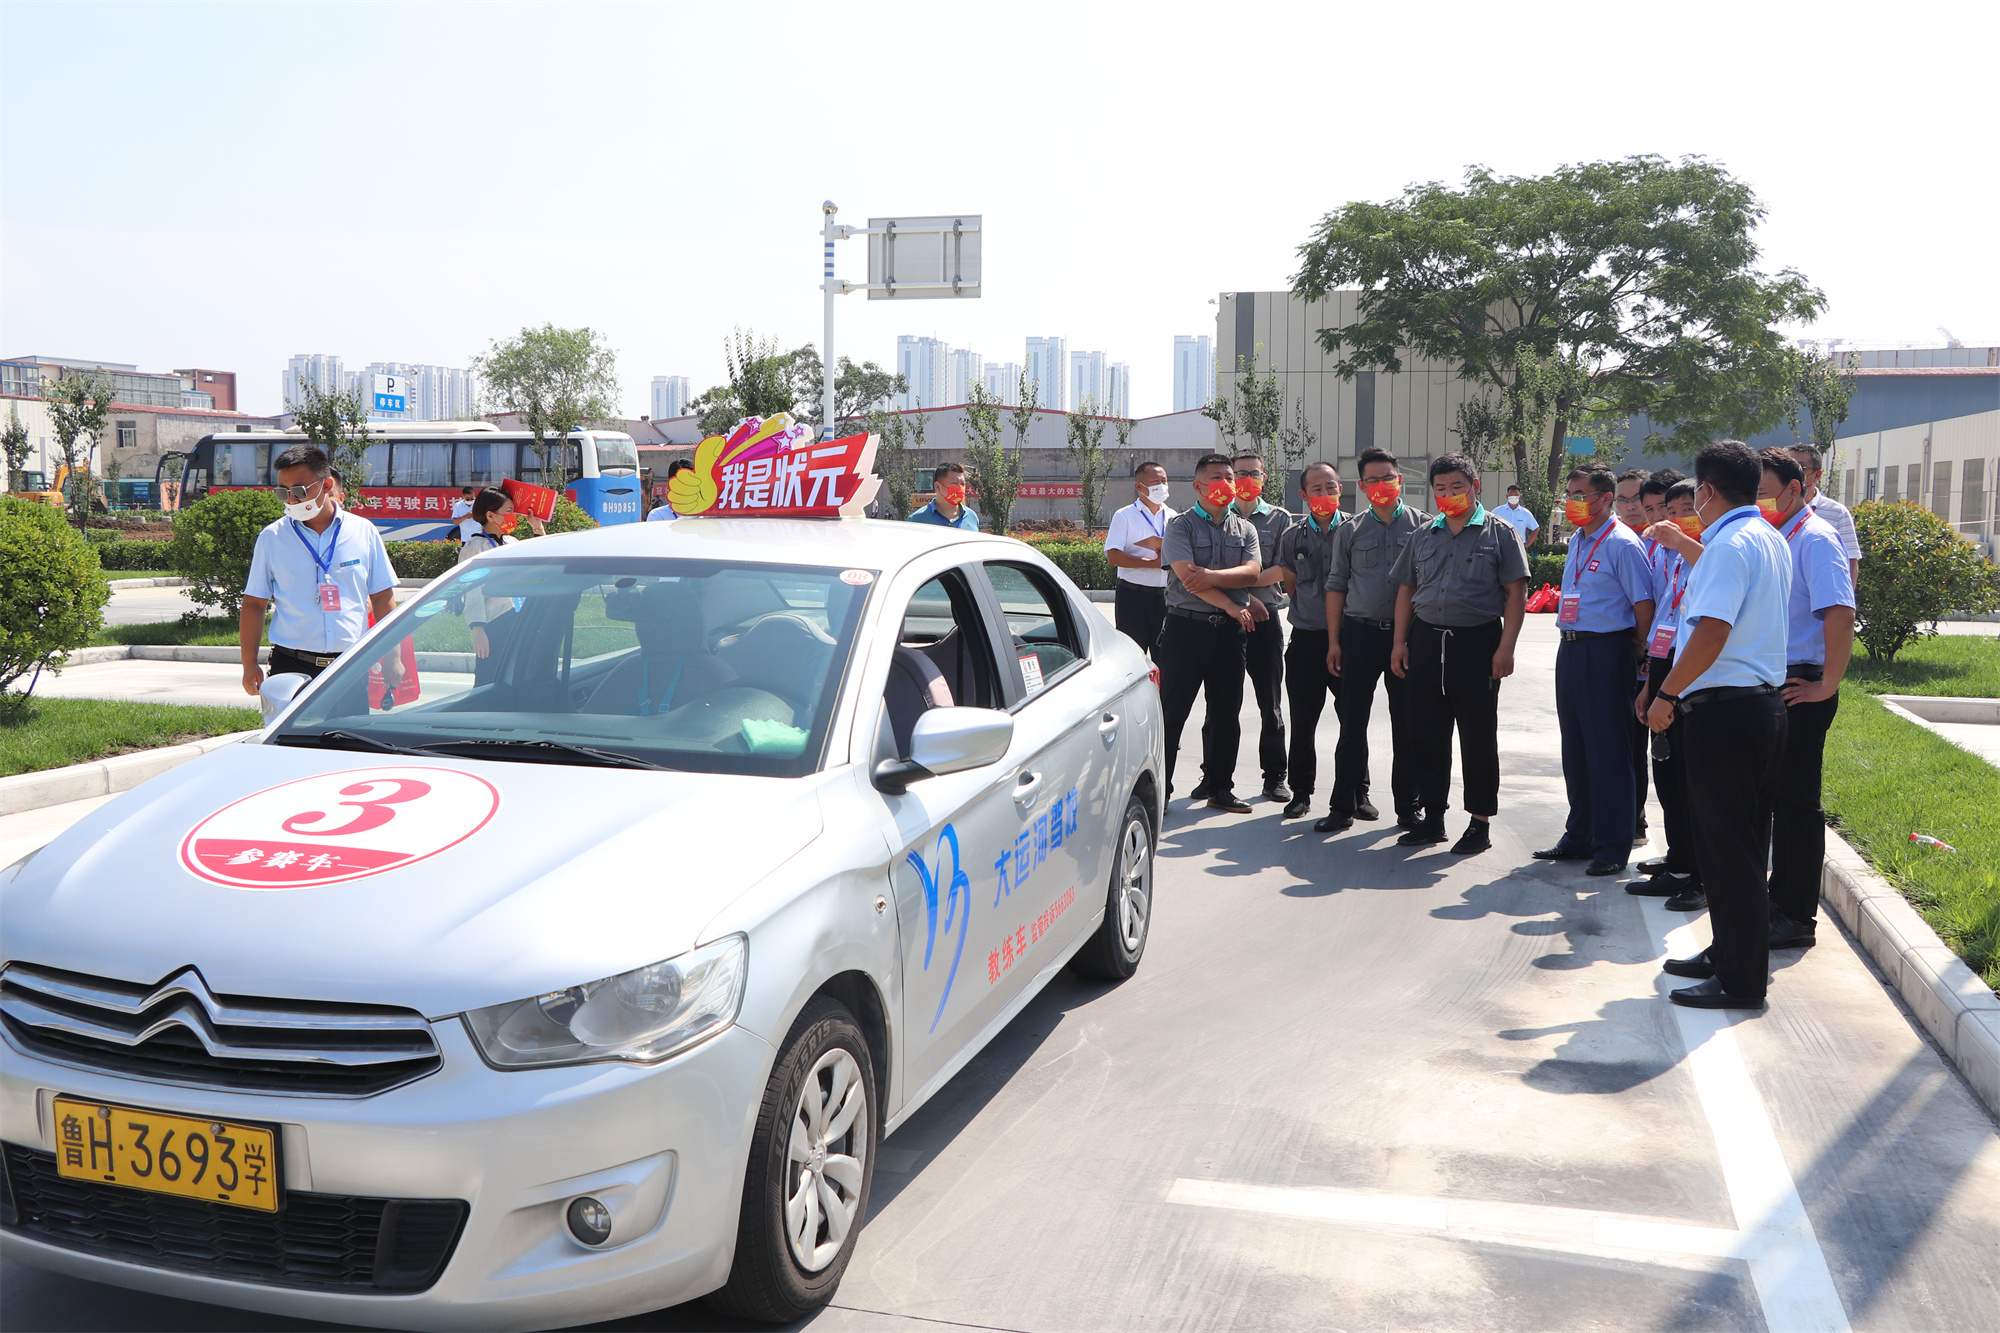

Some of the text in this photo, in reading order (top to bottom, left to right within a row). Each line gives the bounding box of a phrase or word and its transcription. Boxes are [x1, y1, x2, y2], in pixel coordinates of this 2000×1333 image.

[387, 377, 395, 393] P
[718, 444, 849, 509] 我是状元
[602, 501, 636, 514] 鲁H9D853
[847, 571, 869, 580] 08
[281, 778, 431, 836] 3
[224, 847, 341, 872] 参赛车
[993, 787, 1079, 909] 大运河驾校
[988, 924, 1027, 985] 教练车
